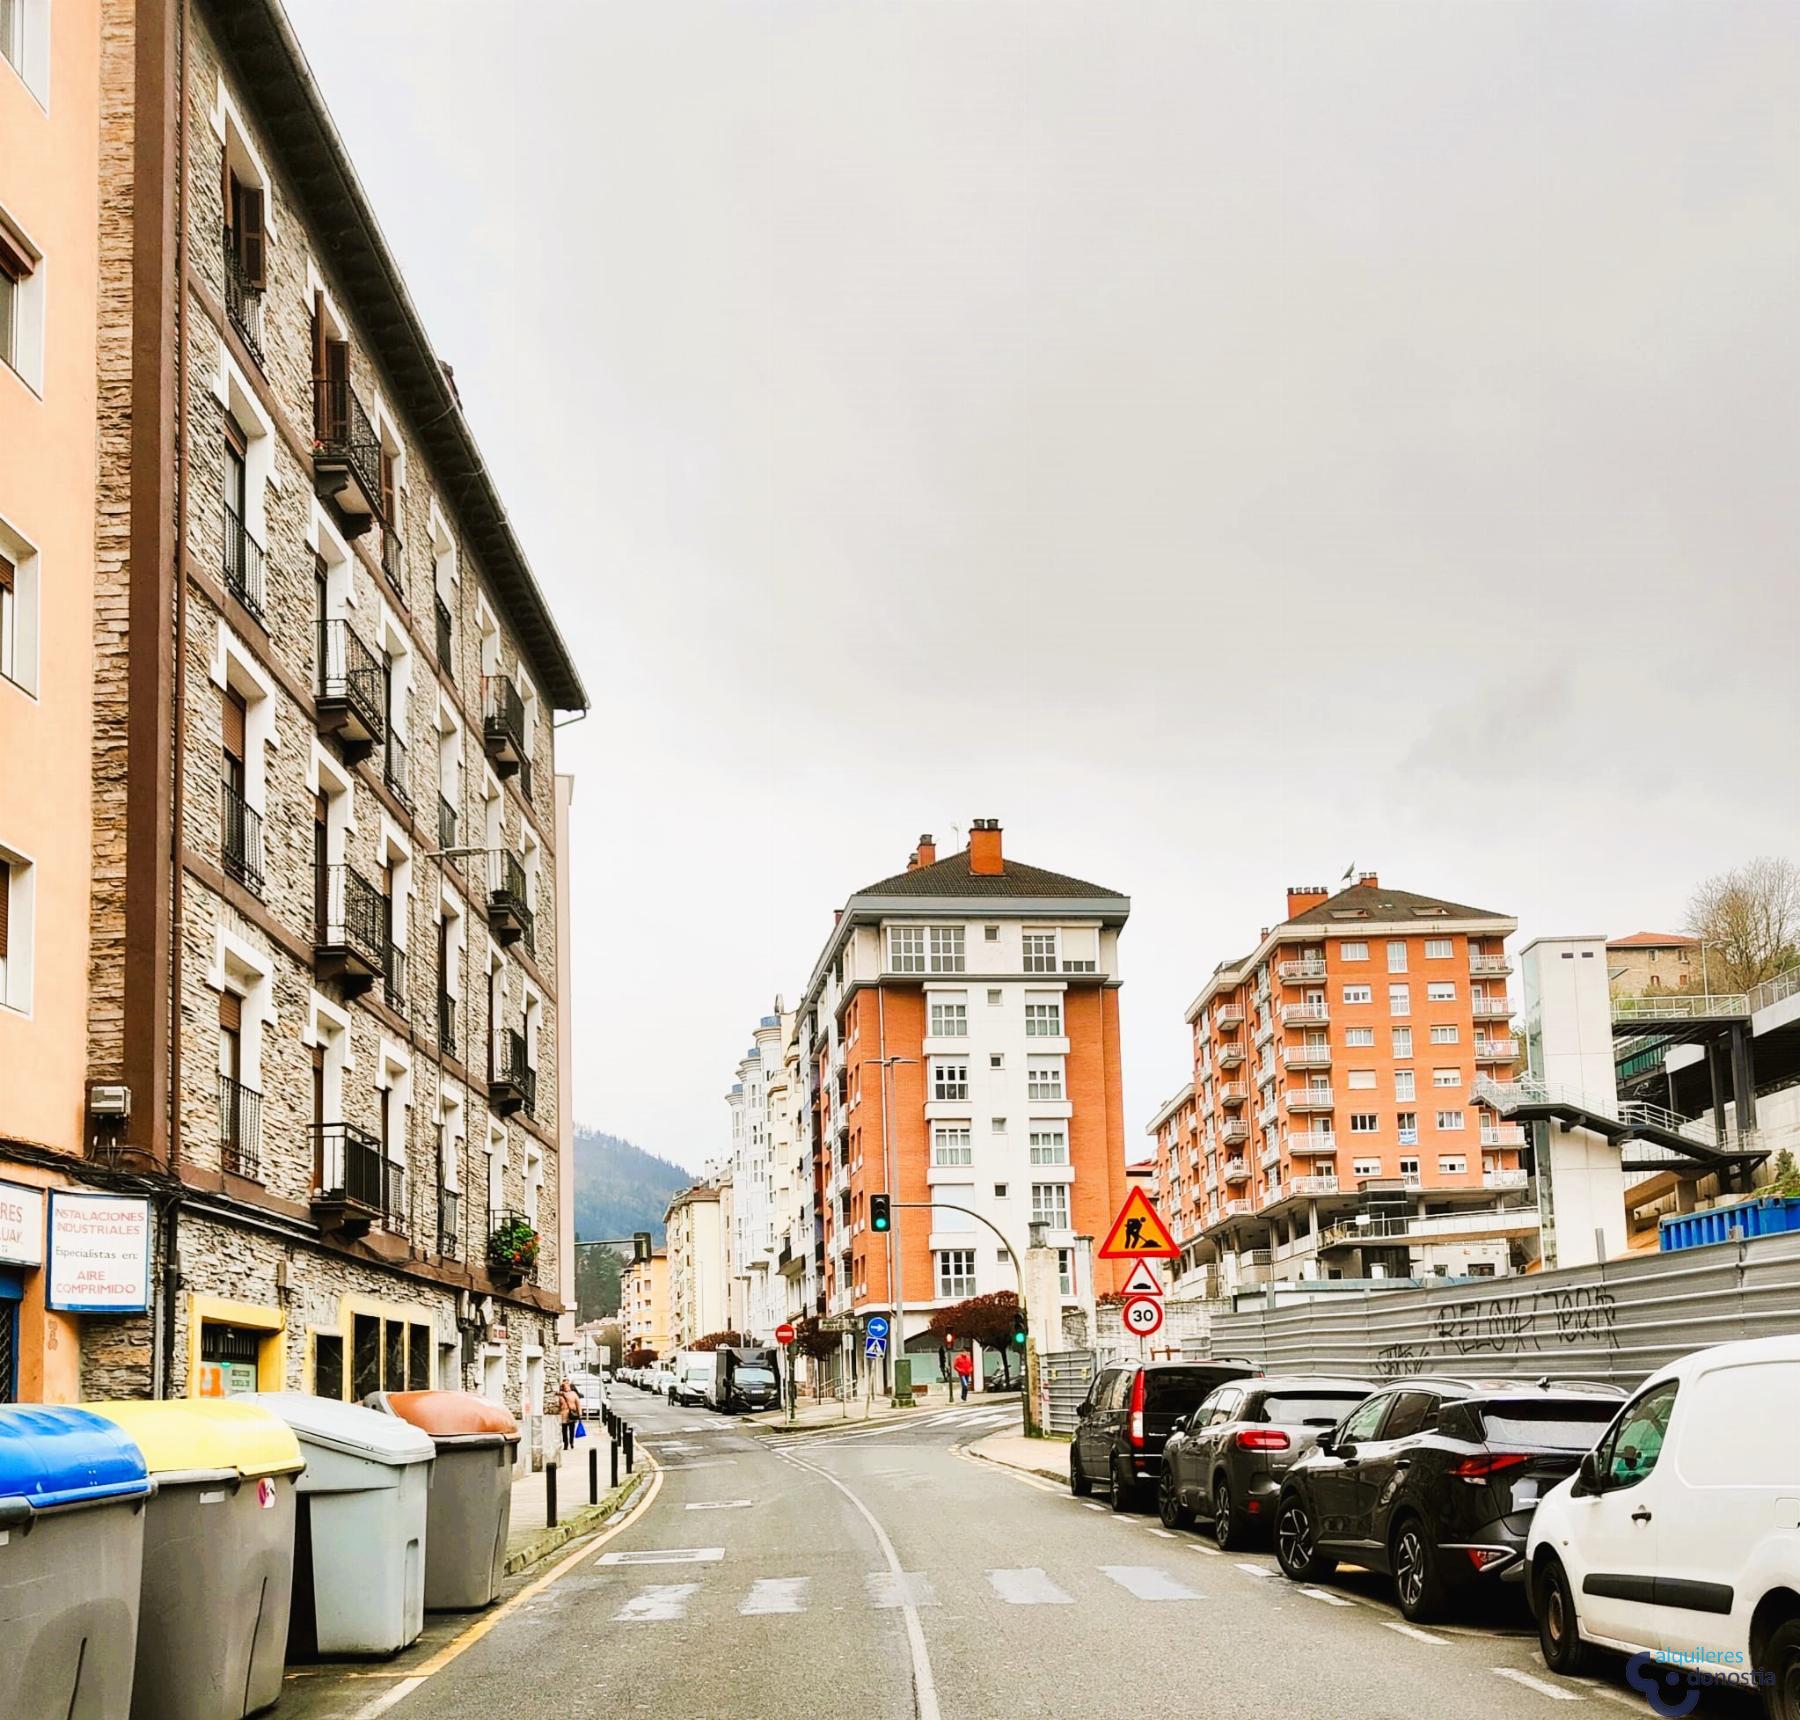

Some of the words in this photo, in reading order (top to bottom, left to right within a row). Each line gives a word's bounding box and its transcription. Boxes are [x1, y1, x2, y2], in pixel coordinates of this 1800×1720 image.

[55, 1246, 116, 1259] Especialistas
[77, 1270, 106, 1281] AIRE
[56, 1283, 137, 1294] COMPRIMIDO
[1132, 1309, 1154, 1322] 30
